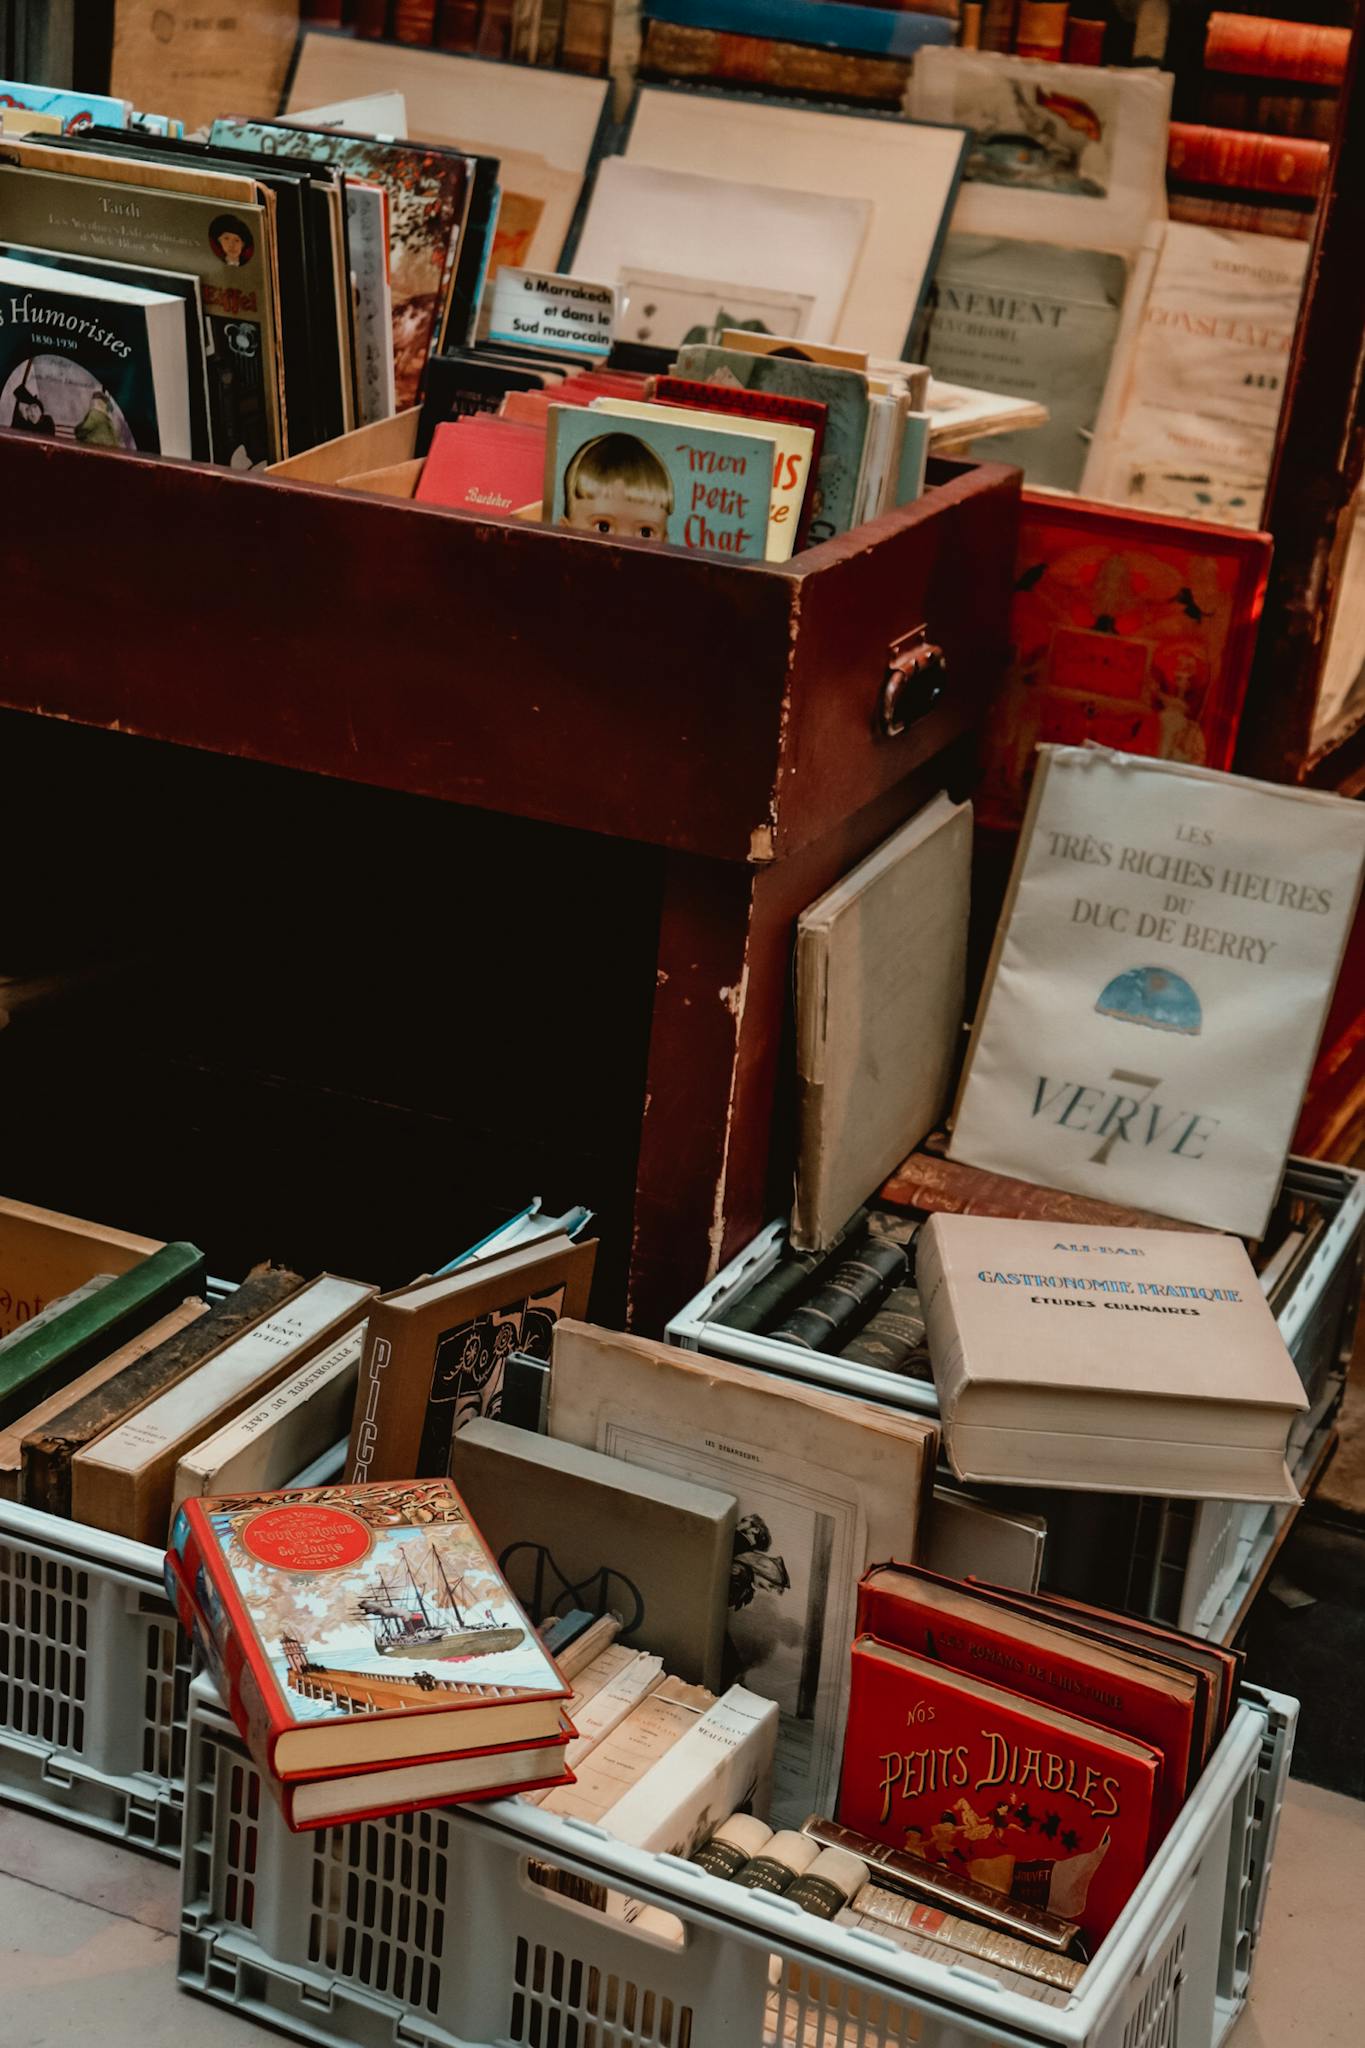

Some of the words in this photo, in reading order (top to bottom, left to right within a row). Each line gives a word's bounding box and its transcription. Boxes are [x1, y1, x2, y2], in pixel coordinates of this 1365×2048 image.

[536, 280, 613, 305] Marrakech
[10, 292, 133, 359] Humoristes
[512, 317, 540, 334] Sud
[542, 324, 611, 345] marocain
[544, 305, 559, 318] et
[561, 306, 595, 323] dans
[597, 311, 611, 326] le
[691, 480, 749, 519] petit
[684, 514, 753, 554] Chat
[1175, 822, 1215, 847] LES
[1046, 831, 1113, 867] TRÈS
[1118, 846, 1217, 890] RICHES
[1218, 868, 1334, 916] HEURES
[1163, 893, 1193, 916] DU
[1071, 896, 1131, 934] DUC
[1135, 912, 1178, 944] DE
[1180, 922, 1278, 965] BERRY
[1031, 1075, 1221, 1160] VERVE
[977, 1270, 1136, 1295] GASTRONOMIE
[1136, 1283, 1244, 1304] PRATIQUE
[1103, 1301, 1201, 1316] CULINAIRES
[287, 1346, 354, 1398] PITTORESQUE
[905, 1699, 937, 1727] NOS
[878, 1744, 972, 1823] PETITS
[973, 1728, 1121, 1818] DIABLES
